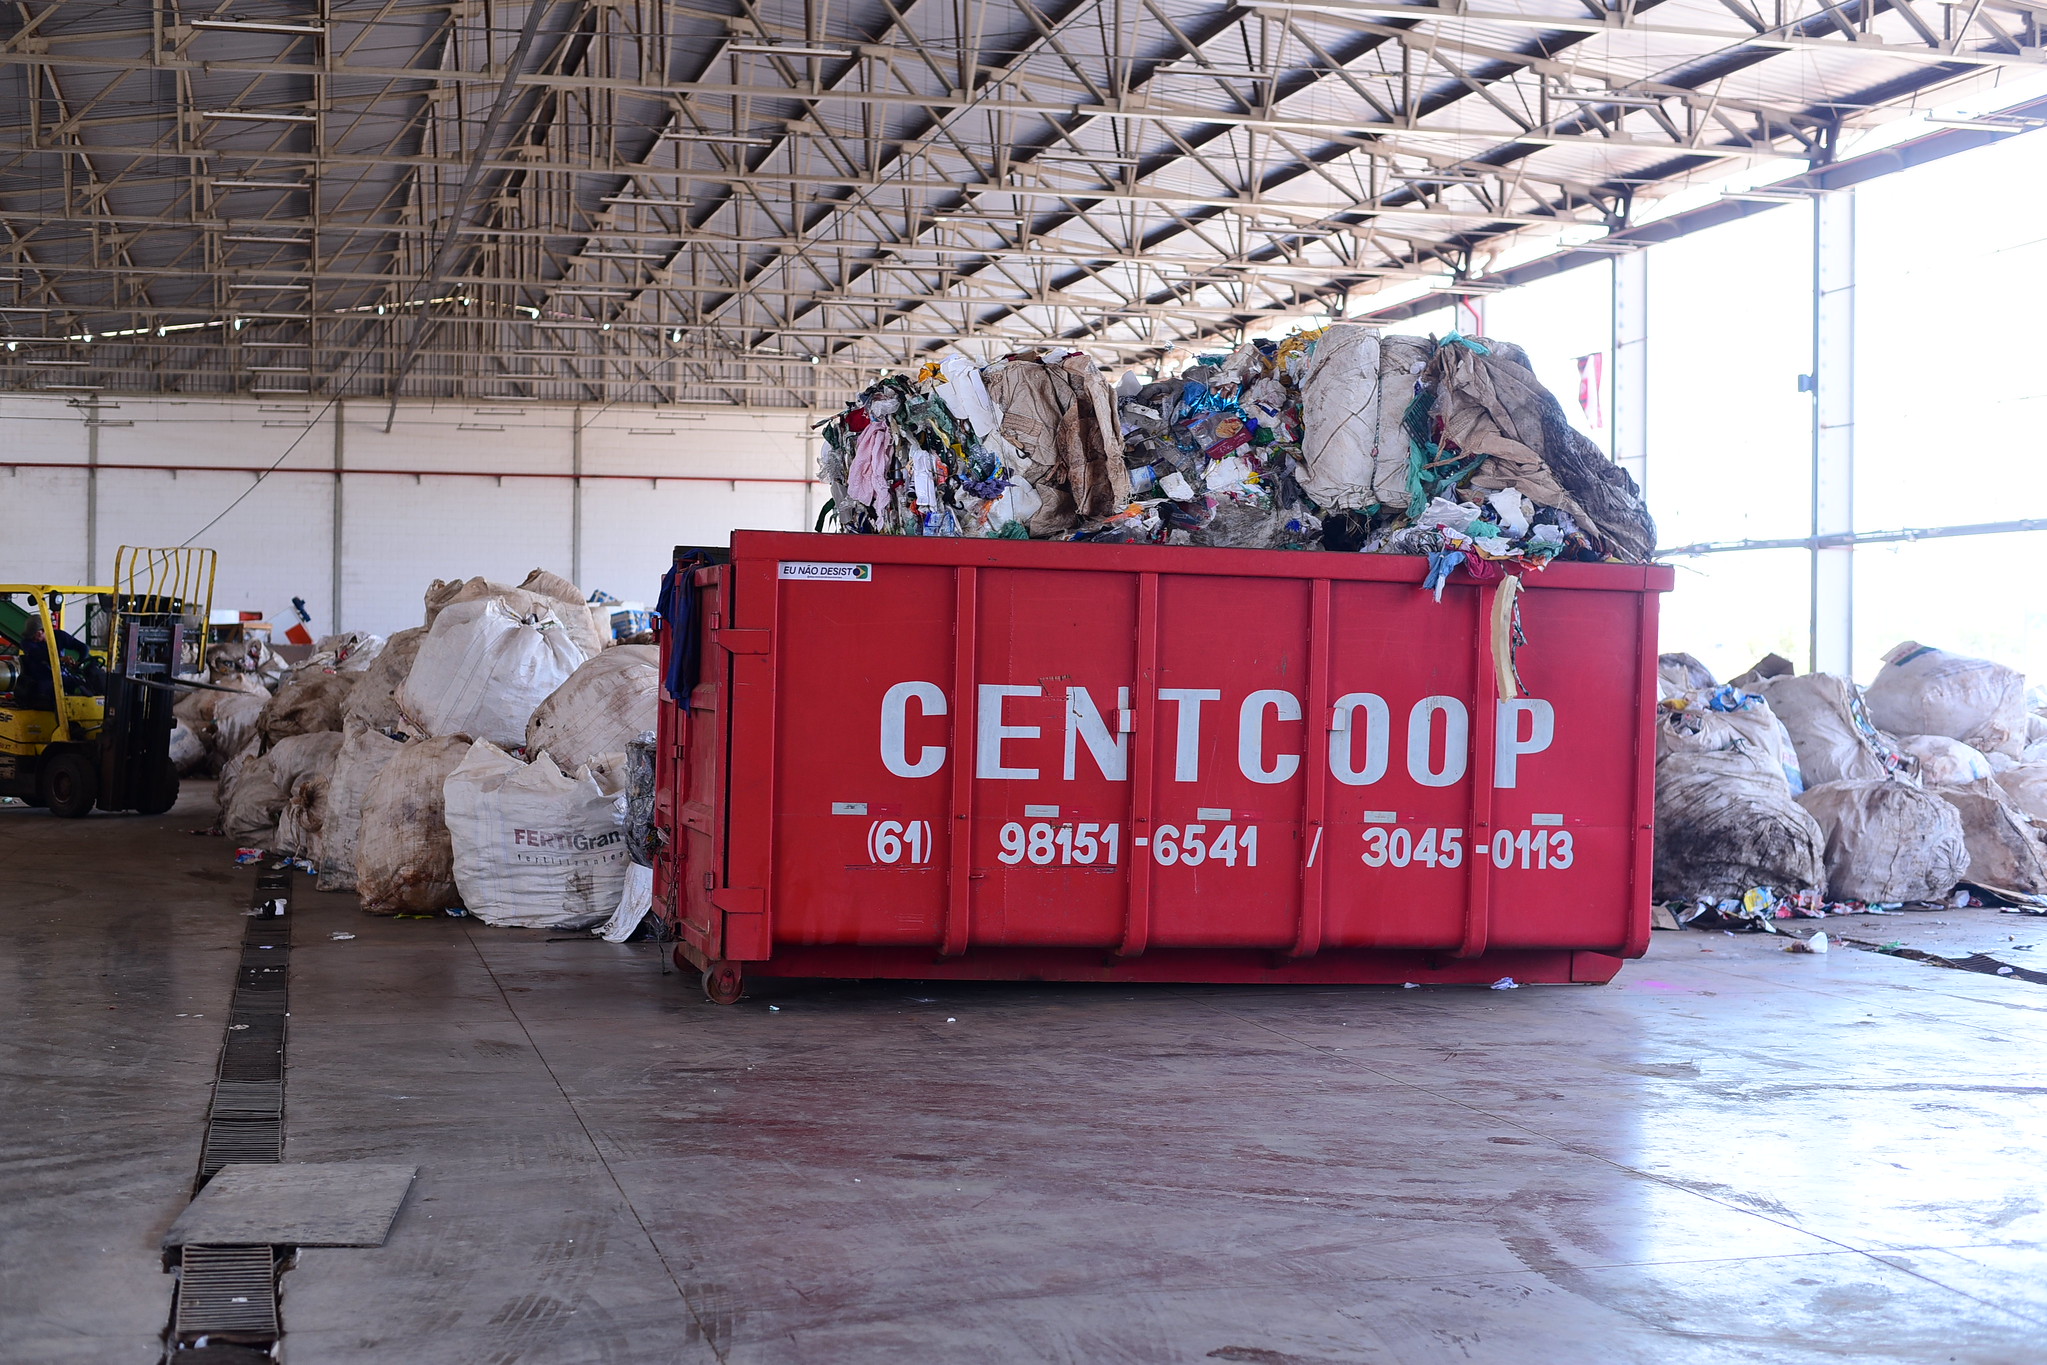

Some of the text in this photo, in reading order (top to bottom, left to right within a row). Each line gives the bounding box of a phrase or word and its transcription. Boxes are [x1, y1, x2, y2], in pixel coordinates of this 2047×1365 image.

[783, 566, 797, 575] EU
[798, 564, 819, 576] NÃO
[880, 681, 1556, 789] CENTCOOP
[867, 820, 932, 865] (61)
